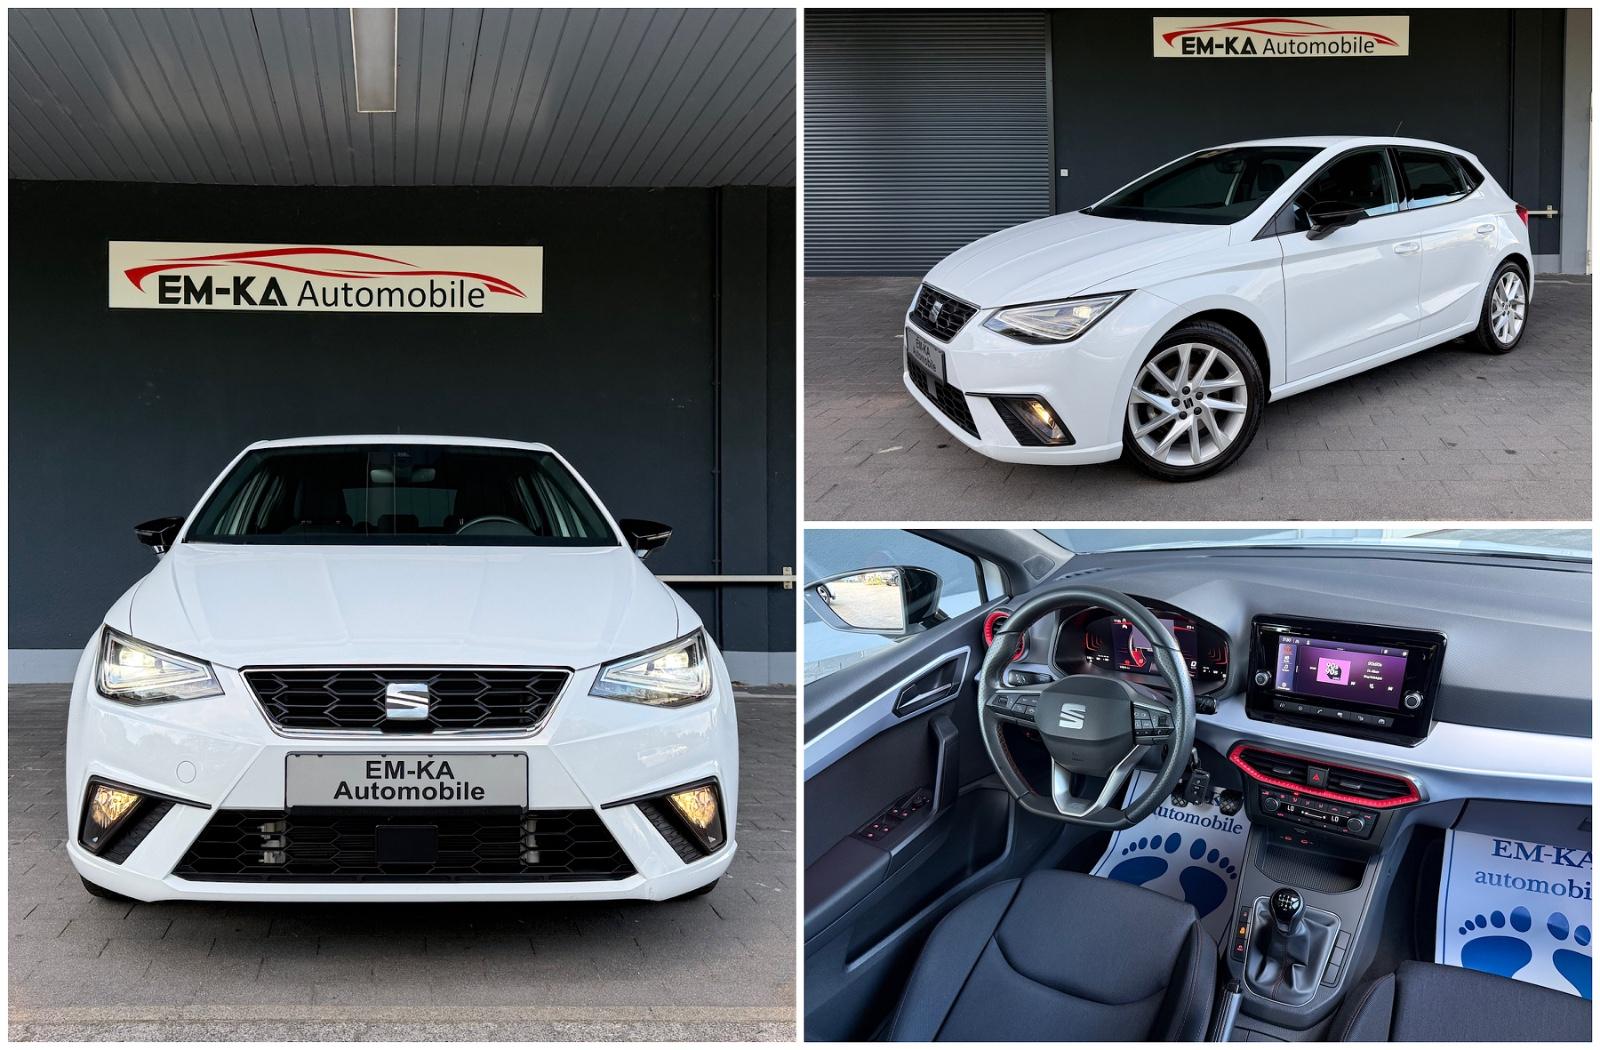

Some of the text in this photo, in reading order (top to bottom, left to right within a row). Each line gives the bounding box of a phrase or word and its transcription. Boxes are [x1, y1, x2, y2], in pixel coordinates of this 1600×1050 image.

[1181, 36, 1375, 55] EM-KA Automobile
[157, 274, 485, 308] EM-KA Automobile
[365, 760, 455, 780] EM-KA
[333, 781, 485, 800] Automobile
